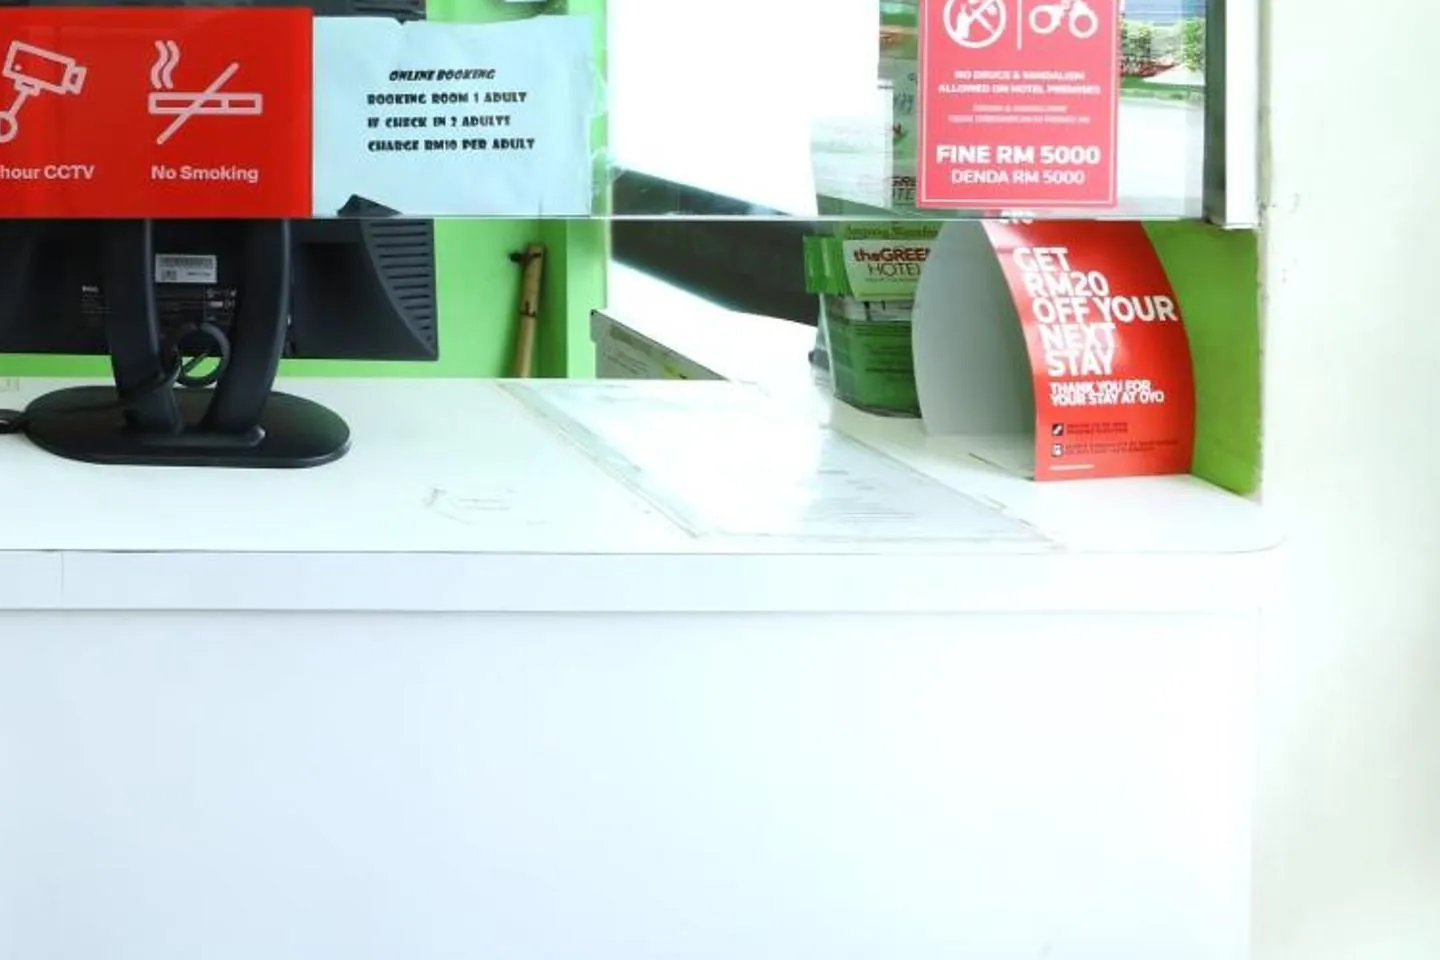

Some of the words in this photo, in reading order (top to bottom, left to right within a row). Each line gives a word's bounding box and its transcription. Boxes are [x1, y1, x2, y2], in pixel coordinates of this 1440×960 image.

[389, 70, 435, 81] ONLINE
[436, 69, 496, 81] BOOKING
[367, 93, 427, 105] BOOKING
[431, 92, 469, 104] ROOM
[473, 93, 479, 103] 1
[484, 92, 527, 103] ADULT
[385, 116, 427, 128] CHECK
[433, 116, 446, 127] IN
[450, 116, 457, 127] 2
[462, 115, 510, 127] ADULTS
[368, 140, 419, 152] CHARGE
[462, 139, 487, 150] PER
[492, 138, 535, 150] ADULT
[936, 145, 990, 164] FINE
[996, 145, 1035, 164] RM
[1040, 145, 1101, 164] 5000
[0, 165, 40, 179] hour
[44, 165, 95, 179] CCTV
[151, 165, 176, 180] No
[180, 165, 259, 182] Smoking
[952, 170, 1010, 184] DENDA
[1013, 170, 1039, 184] RM
[1043, 170, 1086, 185] 5000
[1013, 247, 1071, 272] GET
[1023, 270, 1110, 298] RM20
[1032, 296, 1090, 323] OFF
[1092, 295, 1178, 323] YOUR
[1038, 323, 1116, 351] NEXT
[1047, 350, 1116, 376] STAY
[1125, 379, 1151, 392] FOR
[1139, 391, 1165, 404] OYO
